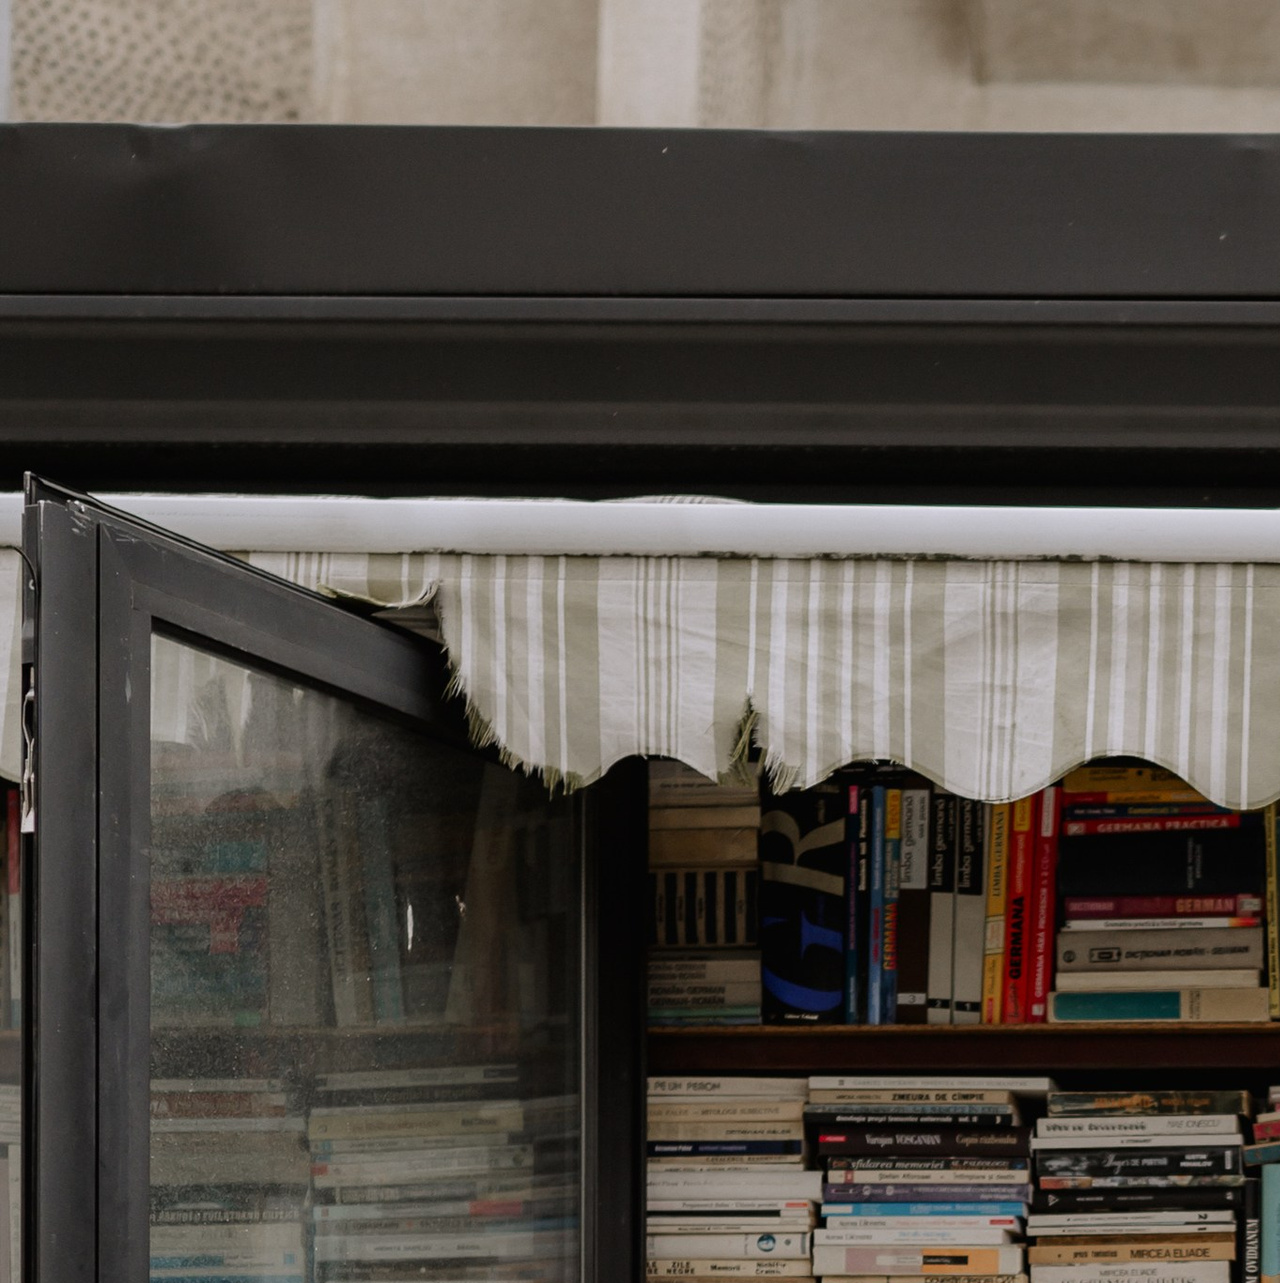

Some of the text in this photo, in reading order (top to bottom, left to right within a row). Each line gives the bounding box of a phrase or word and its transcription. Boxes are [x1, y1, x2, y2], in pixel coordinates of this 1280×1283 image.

[883, 902, 897, 970] GERMANA
[1009, 896, 1024, 979] GERMANA
[1130, 1248, 1210, 1258] MIRCEA ELIADE
[1245, 1219, 1259, 1274] OVIDIANUM
